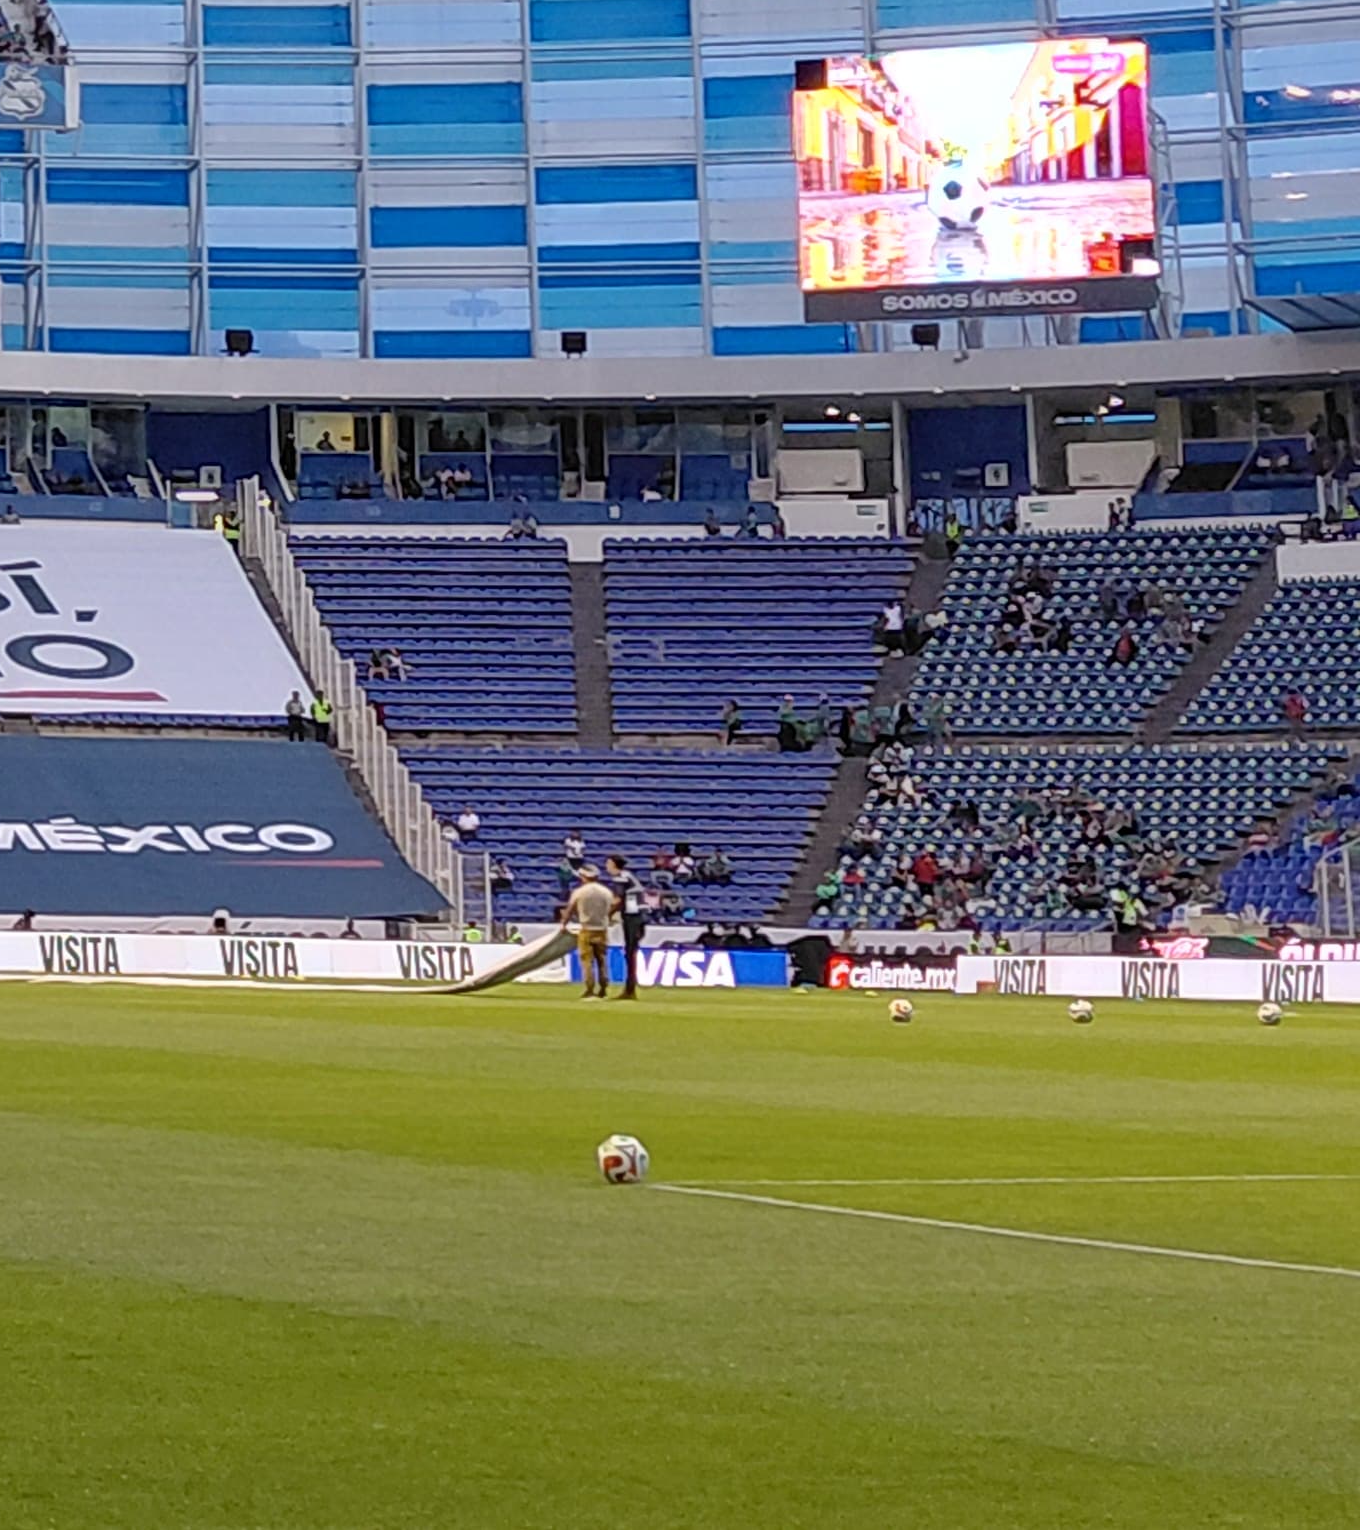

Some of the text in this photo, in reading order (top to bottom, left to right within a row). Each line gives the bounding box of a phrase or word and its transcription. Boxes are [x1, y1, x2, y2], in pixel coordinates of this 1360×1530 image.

[882, 288, 1077, 311] SOMOS MÉXICO
[39, 934, 121, 974] VISITA
[219, 938, 299, 977] VISITA
[396, 944, 475, 981] VISITA
[636, 949, 736, 987] VISA
[850, 960, 957, 991] caliente.mx
[994, 958, 1047, 995] VISITA
[1121, 960, 1180, 999] VISITA
[1262, 963, 1324, 1002] VISITA
